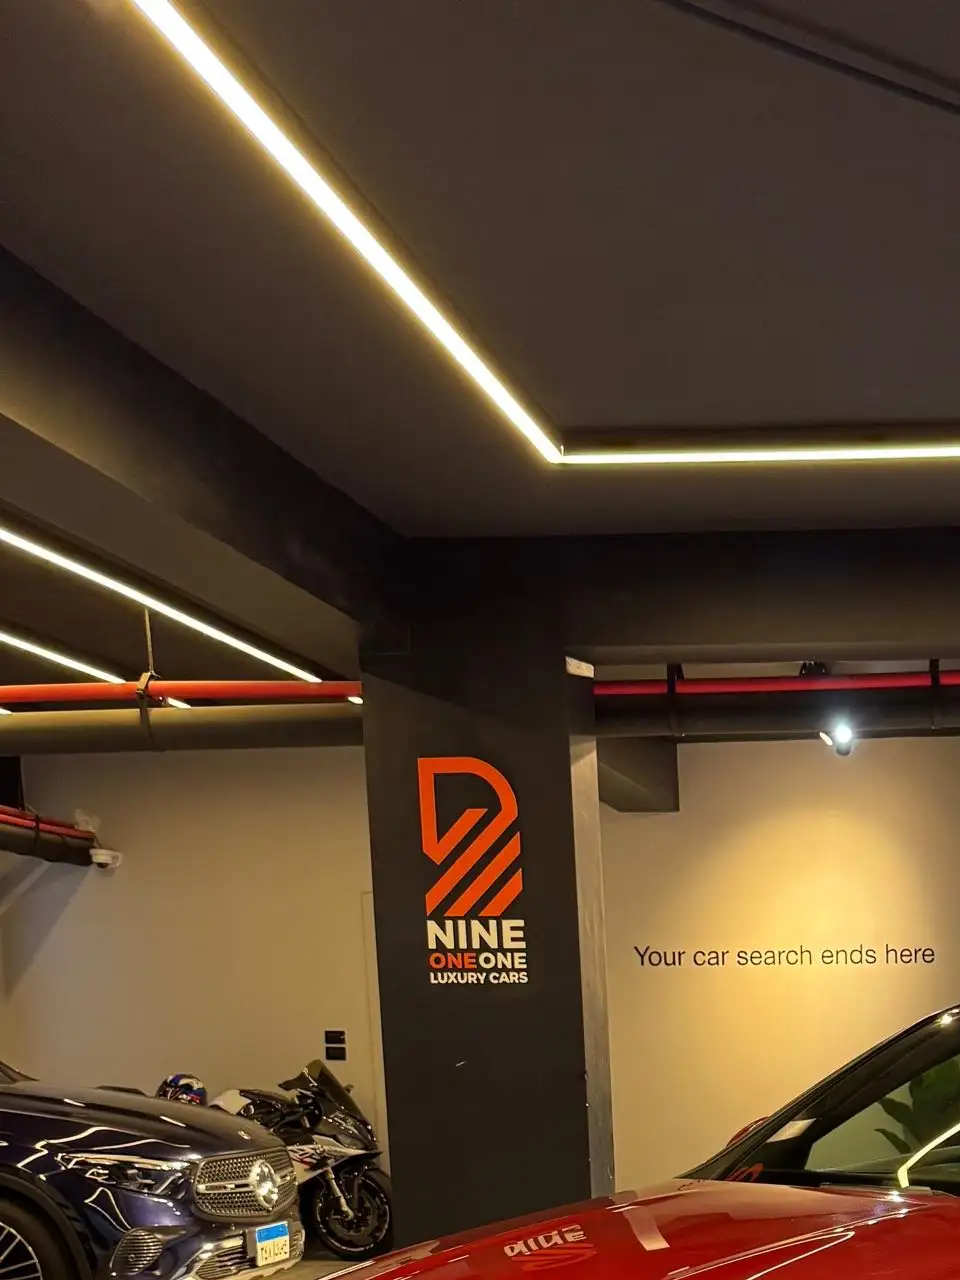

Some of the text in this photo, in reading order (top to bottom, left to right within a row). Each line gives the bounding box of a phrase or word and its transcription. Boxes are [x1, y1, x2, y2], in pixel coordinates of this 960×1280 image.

[426, 918, 527, 950] NINE
[633, 943, 935, 966] Your car search ends here
[430, 971, 529, 984] LUXURY CARS
